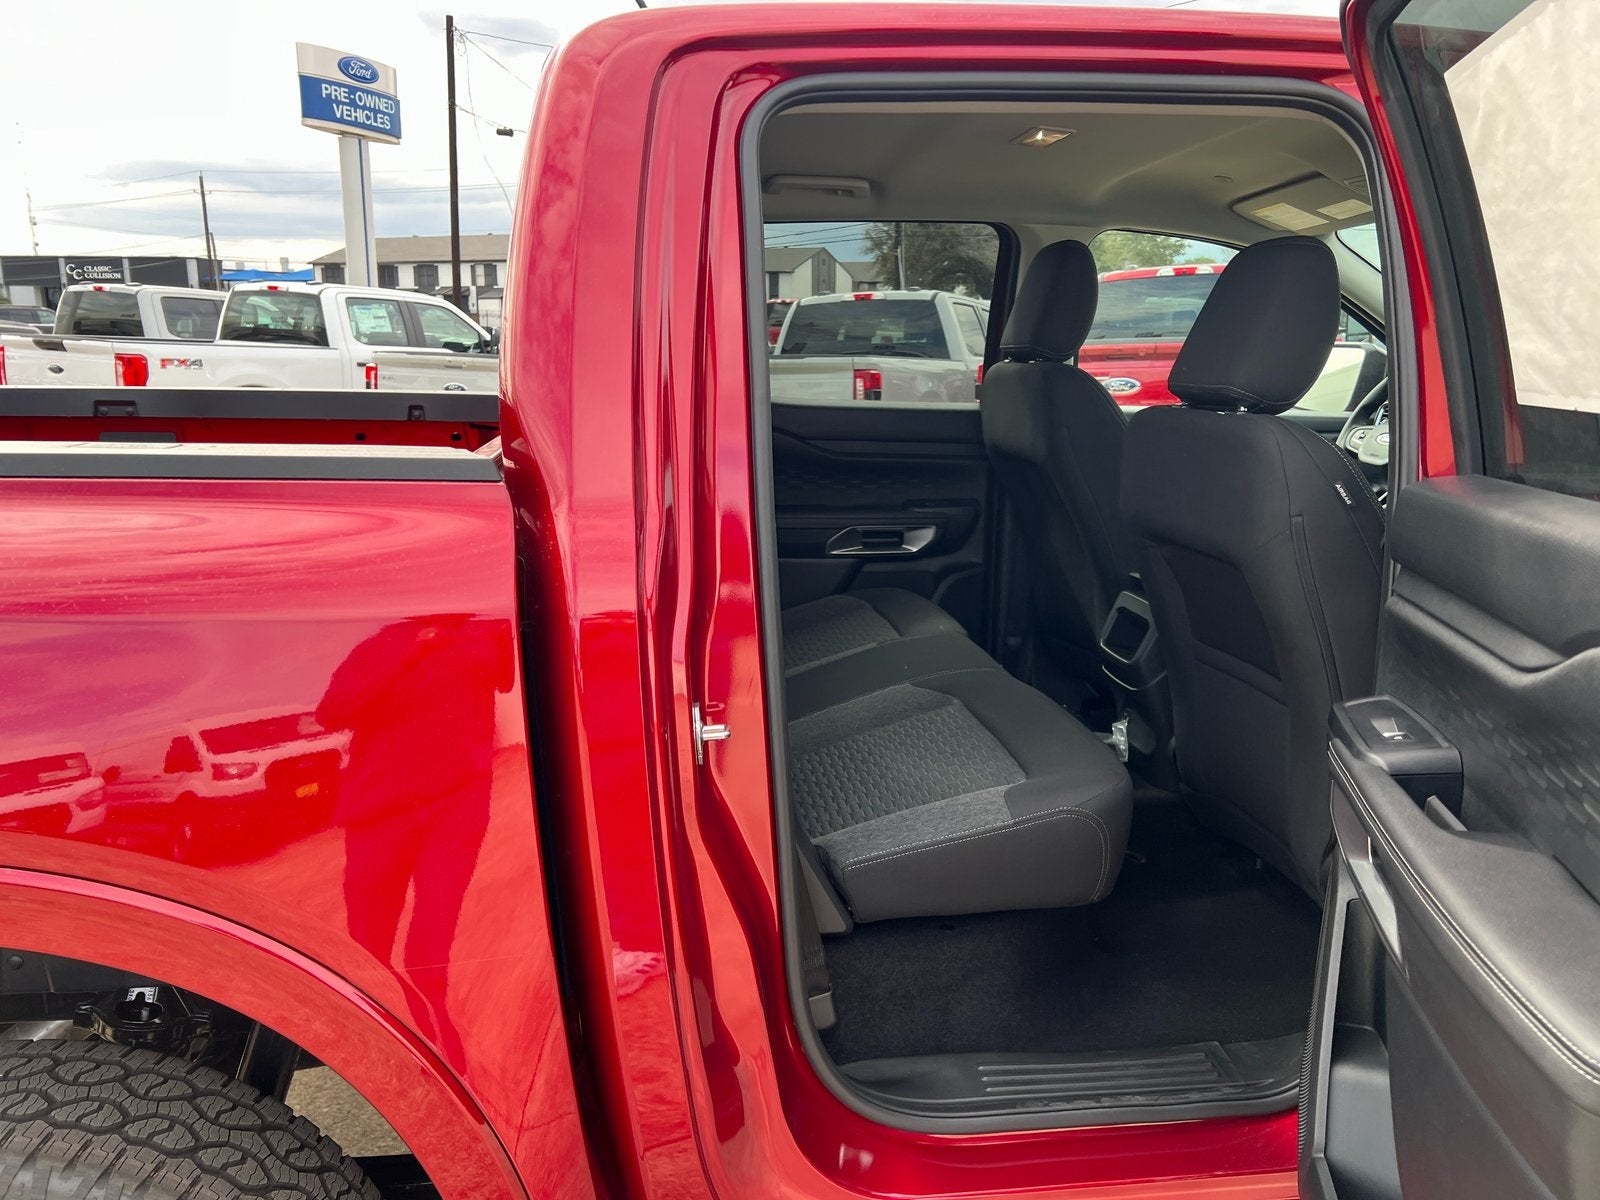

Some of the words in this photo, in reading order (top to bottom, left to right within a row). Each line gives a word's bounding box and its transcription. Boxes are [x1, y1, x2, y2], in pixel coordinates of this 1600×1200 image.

[348, 60, 372, 79] Ford
[321, 83, 396, 114] PRE-OWNED
[332, 103, 391, 130] VEHICLES
[160, 358, 204, 369] FX4
[1335, 484, 1352, 505] AIRBAG
